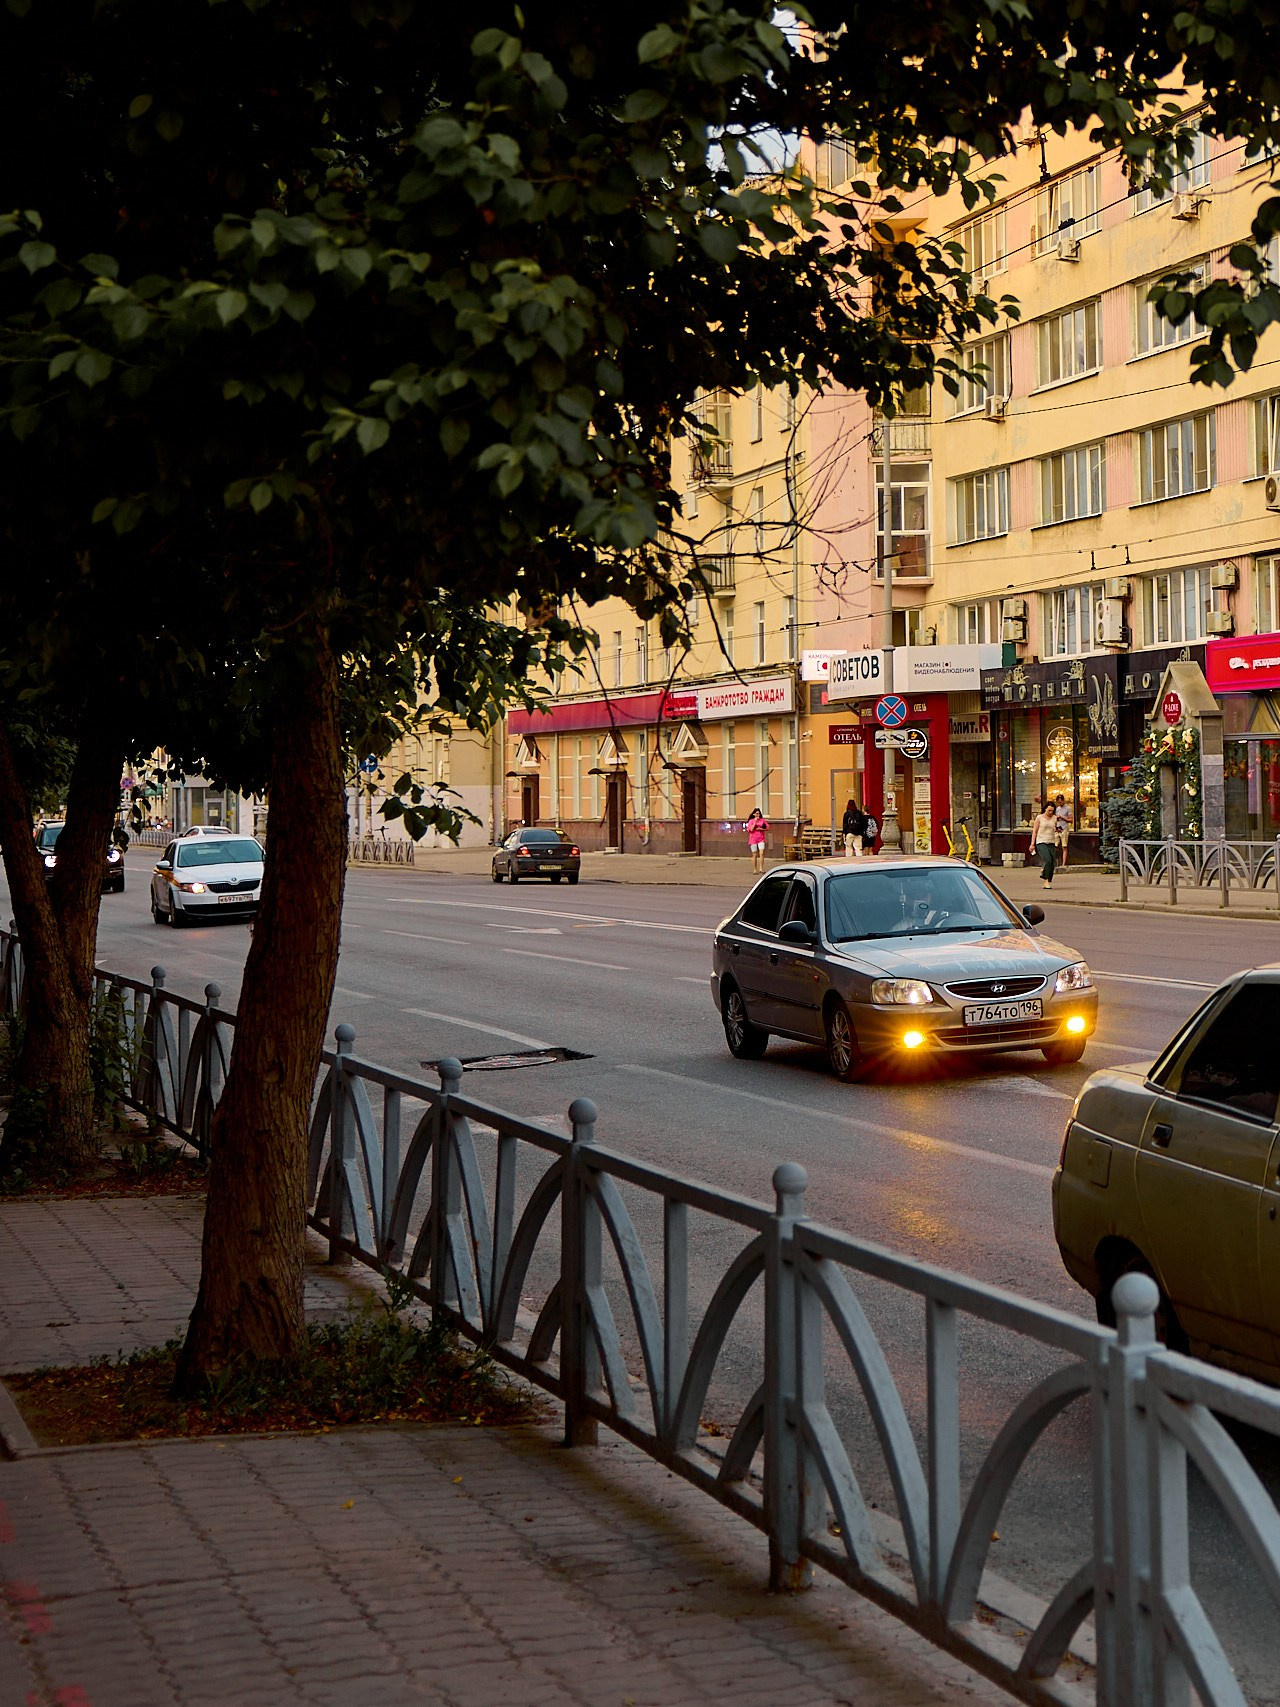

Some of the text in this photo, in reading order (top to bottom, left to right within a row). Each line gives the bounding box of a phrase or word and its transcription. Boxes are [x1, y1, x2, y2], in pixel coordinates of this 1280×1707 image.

[832, 655, 880, 683] СОВЕТОВ
[914, 667, 975, 675] ВИДЕОНАБЛЮДЕНИЯ
[705, 691, 749, 709] БАНКРОТСТВО
[751, 688, 785, 704] ГРАЖДАН
[833, 733, 862, 741] ОТЕЛЬ
[969, 1001, 1038, 1021] Т764ТО 196
